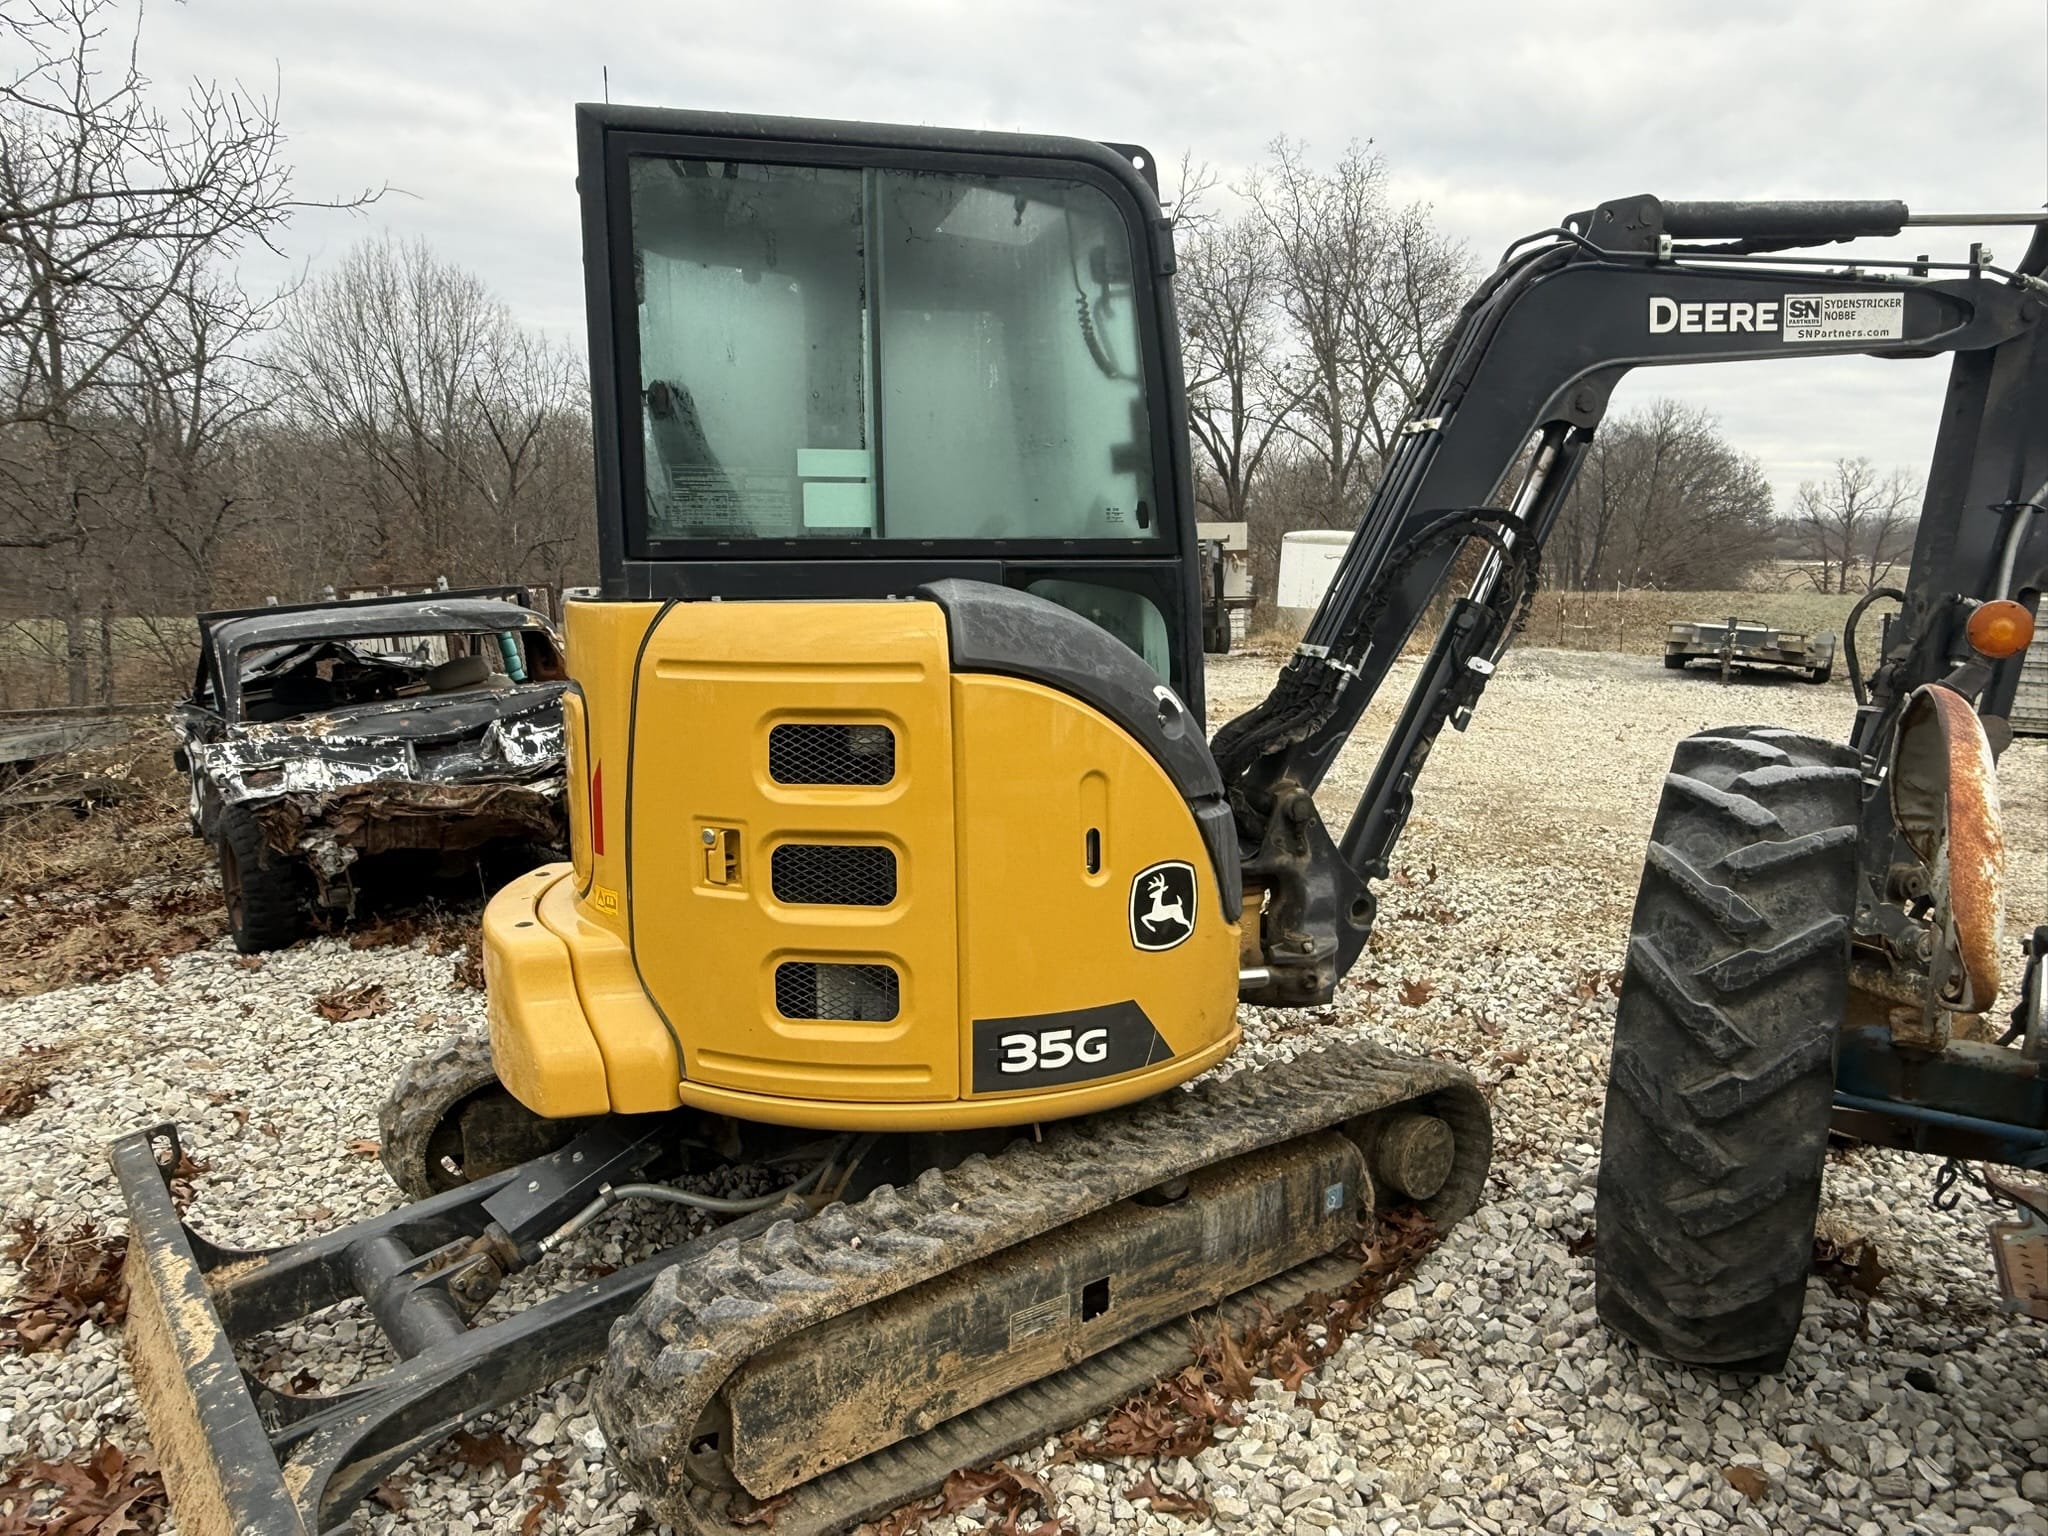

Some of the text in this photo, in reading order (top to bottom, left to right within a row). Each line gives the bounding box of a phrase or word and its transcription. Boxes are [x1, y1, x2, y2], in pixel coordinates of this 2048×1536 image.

[1824, 298, 1902, 309] SYDENSTRICKER
[1649, 297, 1778, 333] DEERE
[1824, 311, 1856, 321] NOBBE
[1797, 329, 1889, 339] SNPartners.com
[1000, 1028, 1108, 1073] 35G
